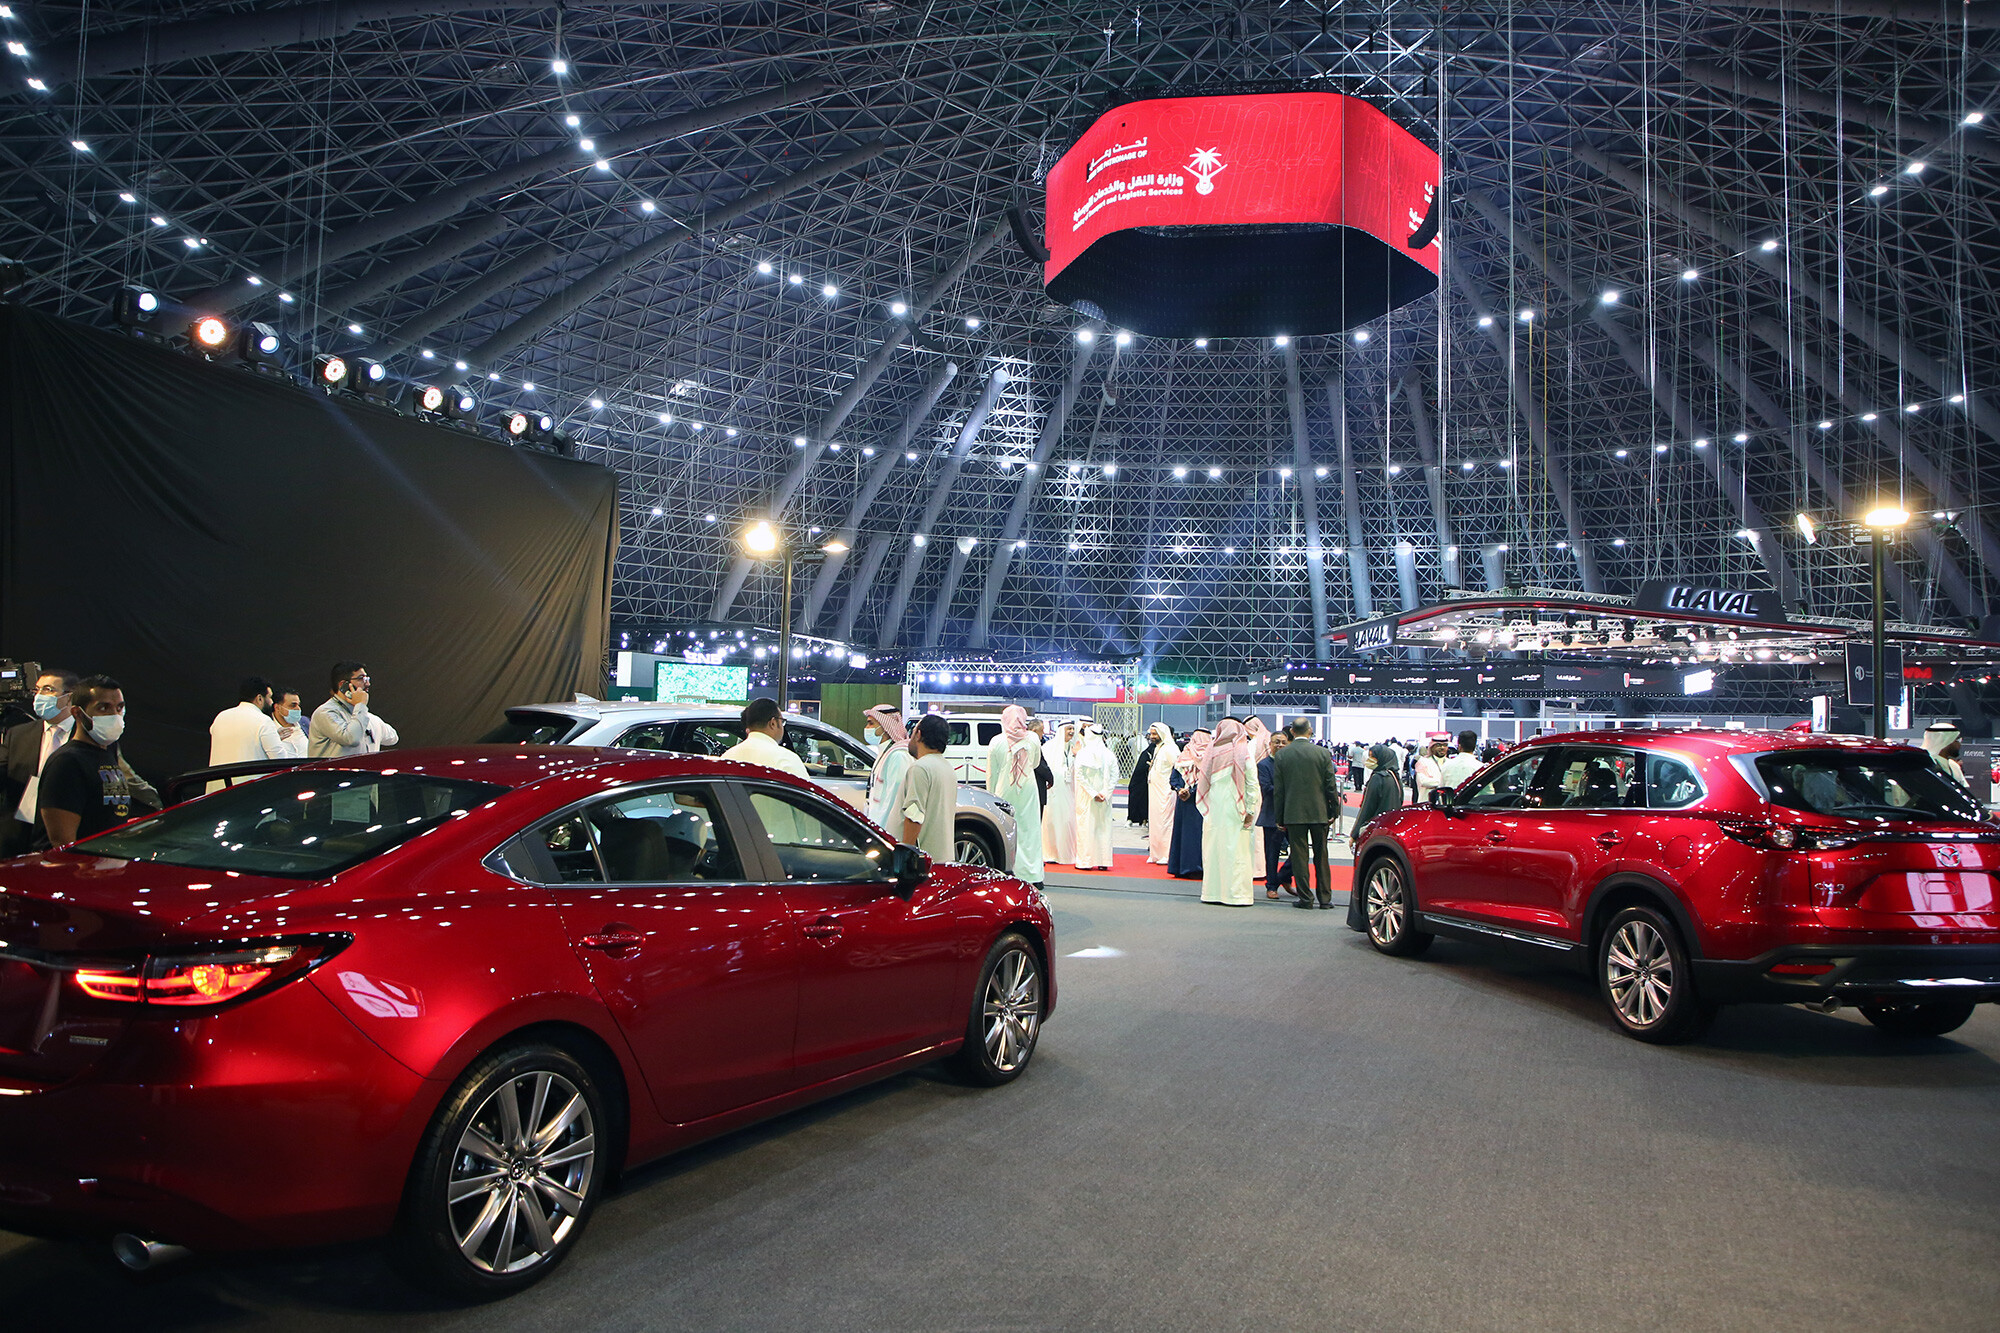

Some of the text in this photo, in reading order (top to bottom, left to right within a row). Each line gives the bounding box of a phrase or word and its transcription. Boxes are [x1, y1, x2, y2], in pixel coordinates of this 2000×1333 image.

[1113, 136, 1148, 153] تحت
[1127, 174, 1155, 190] النقل
[1156, 173, 1184, 187] وزارة
[1118, 189, 1147, 201] Logistic
[1148, 188, 1184, 196] Services
[1668, 586, 1760, 616] HAVAL
